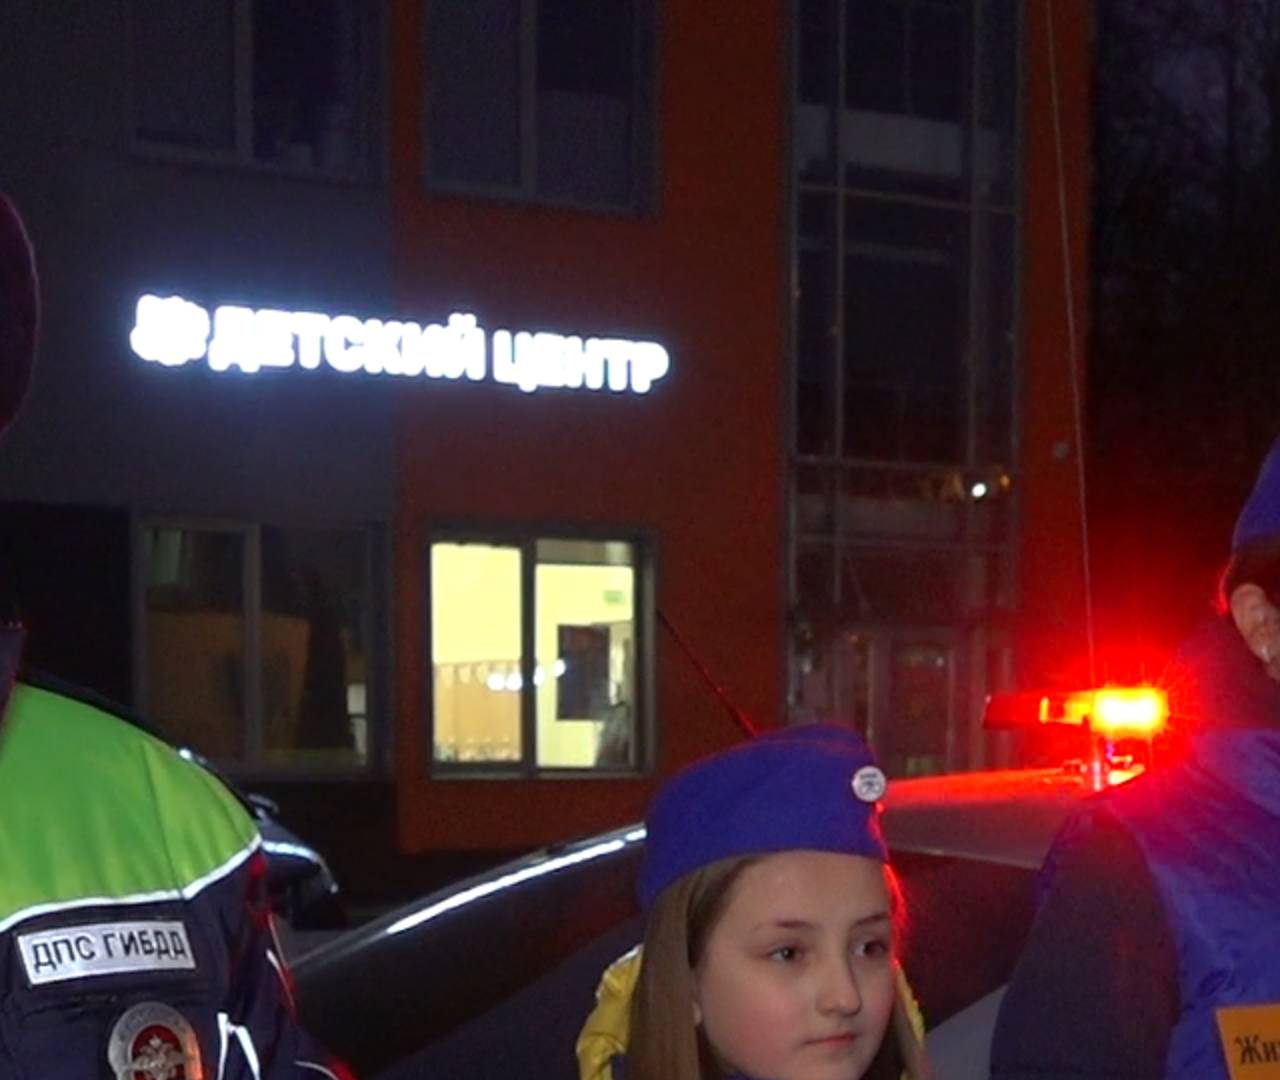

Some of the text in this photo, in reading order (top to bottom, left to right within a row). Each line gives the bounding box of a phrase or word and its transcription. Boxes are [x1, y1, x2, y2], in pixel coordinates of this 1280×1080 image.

[208, 306, 669, 391] ДЕТСКИЙ ЦЕНТР
[32, 930, 187, 973] ДПС ГИБДД
